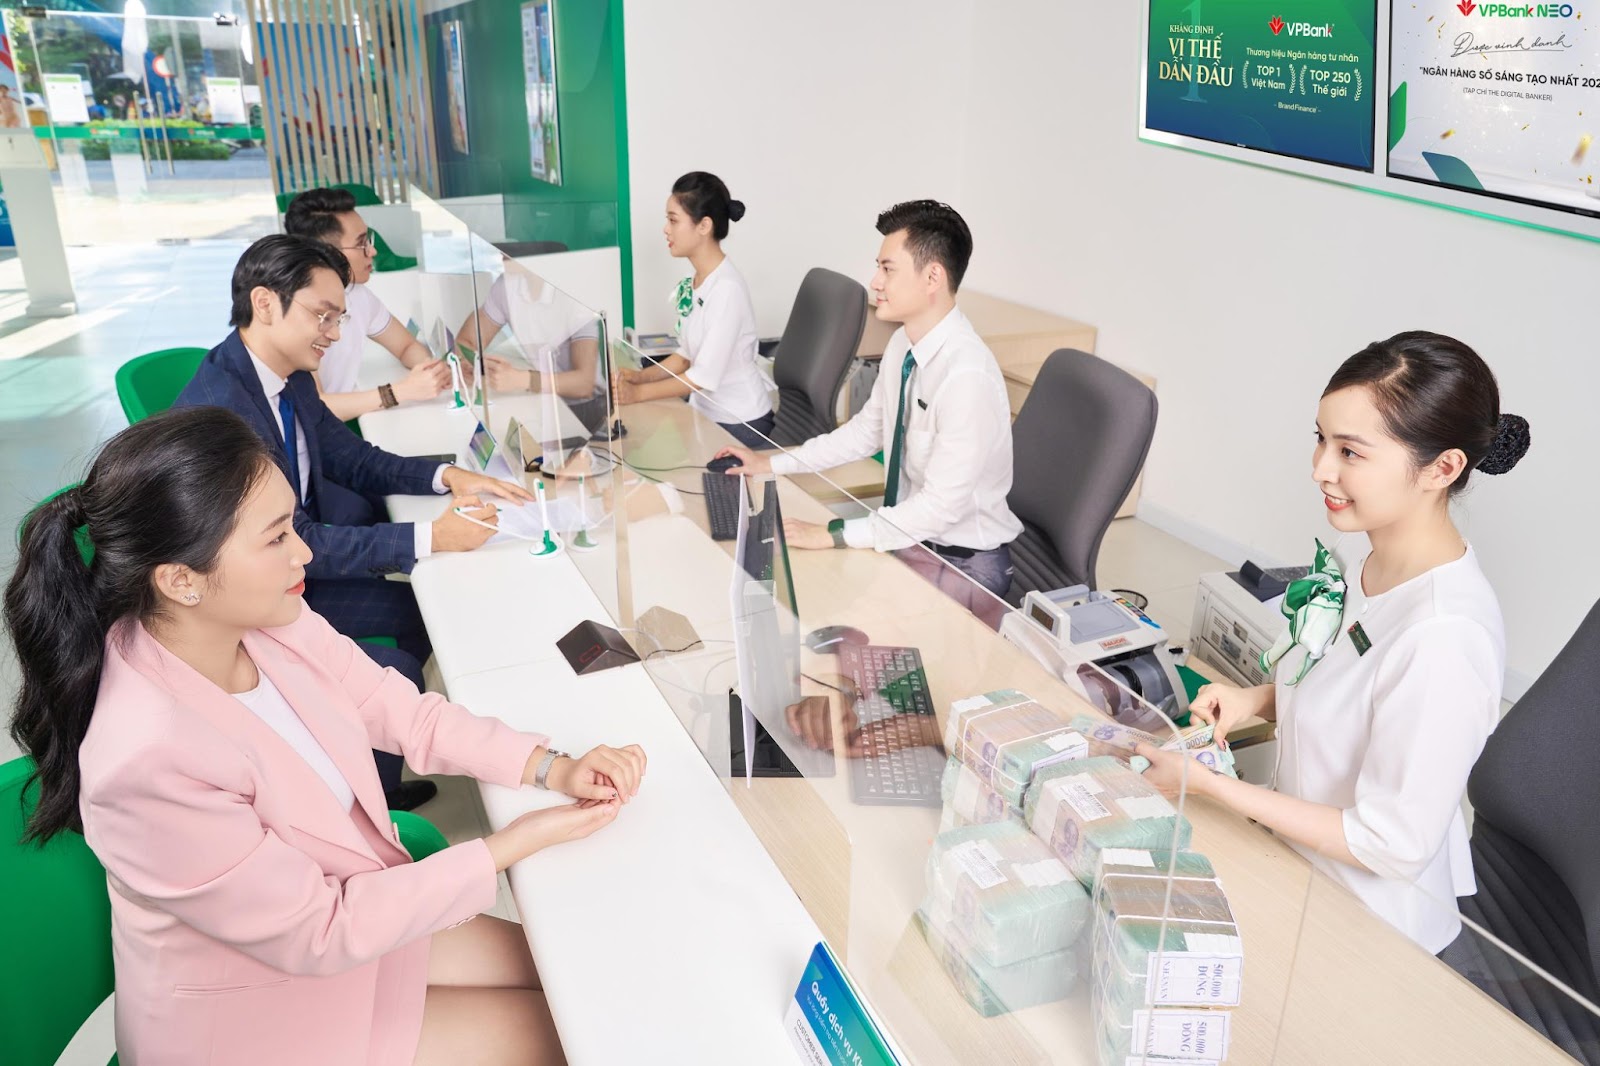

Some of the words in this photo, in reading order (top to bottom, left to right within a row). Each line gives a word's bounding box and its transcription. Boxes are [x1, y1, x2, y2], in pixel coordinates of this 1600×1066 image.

[1479, 4, 1534, 18] VPBank
[1537, 4, 1573, 18] NEO
[1286, 22, 1333, 38] VPBank
[1168, 37, 1185, 61] VỊ
[1187, 32, 1224, 59] THẾ
[1495, 37, 1530, 51] vinh
[1531, 34, 1573, 49] danh
[1246, 47, 1270, 59] Thương
[1271, 49, 1286, 60] hiệu
[1287, 50, 1307, 61] Ngân
[1307, 51, 1327, 62] hàng
[1328, 53, 1337, 61] tư
[1338, 53, 1359, 62] nhân
[1159, 56, 1193, 83] DẪN
[1196, 59, 1234, 87] ĐẦU
[1256, 65, 1275, 77] TOP
[1275, 67, 1281, 77] 1
[1310, 69, 1330, 81] TOP
[1332, 71, 1351, 84] 250
[1450, 67, 1476, 79] HÀNG
[1479, 68, 1493, 80] SỐ
[1495, 70, 1523, 82] SÁNG
[1526, 73, 1547, 86] TẠO
[1550, 73, 1579, 87] NHẤT
[1251, 78, 1266, 90] Việt
[1267, 79, 1286, 90] Nam
[1312, 84, 1329, 95] Thế
[1330, 86, 1347, 98] giới
[1500, 90, 1524, 99] DIGITAL
[828, 1012, 844, 1040] dịch
[843, 1037, 854, 1057] vụ
